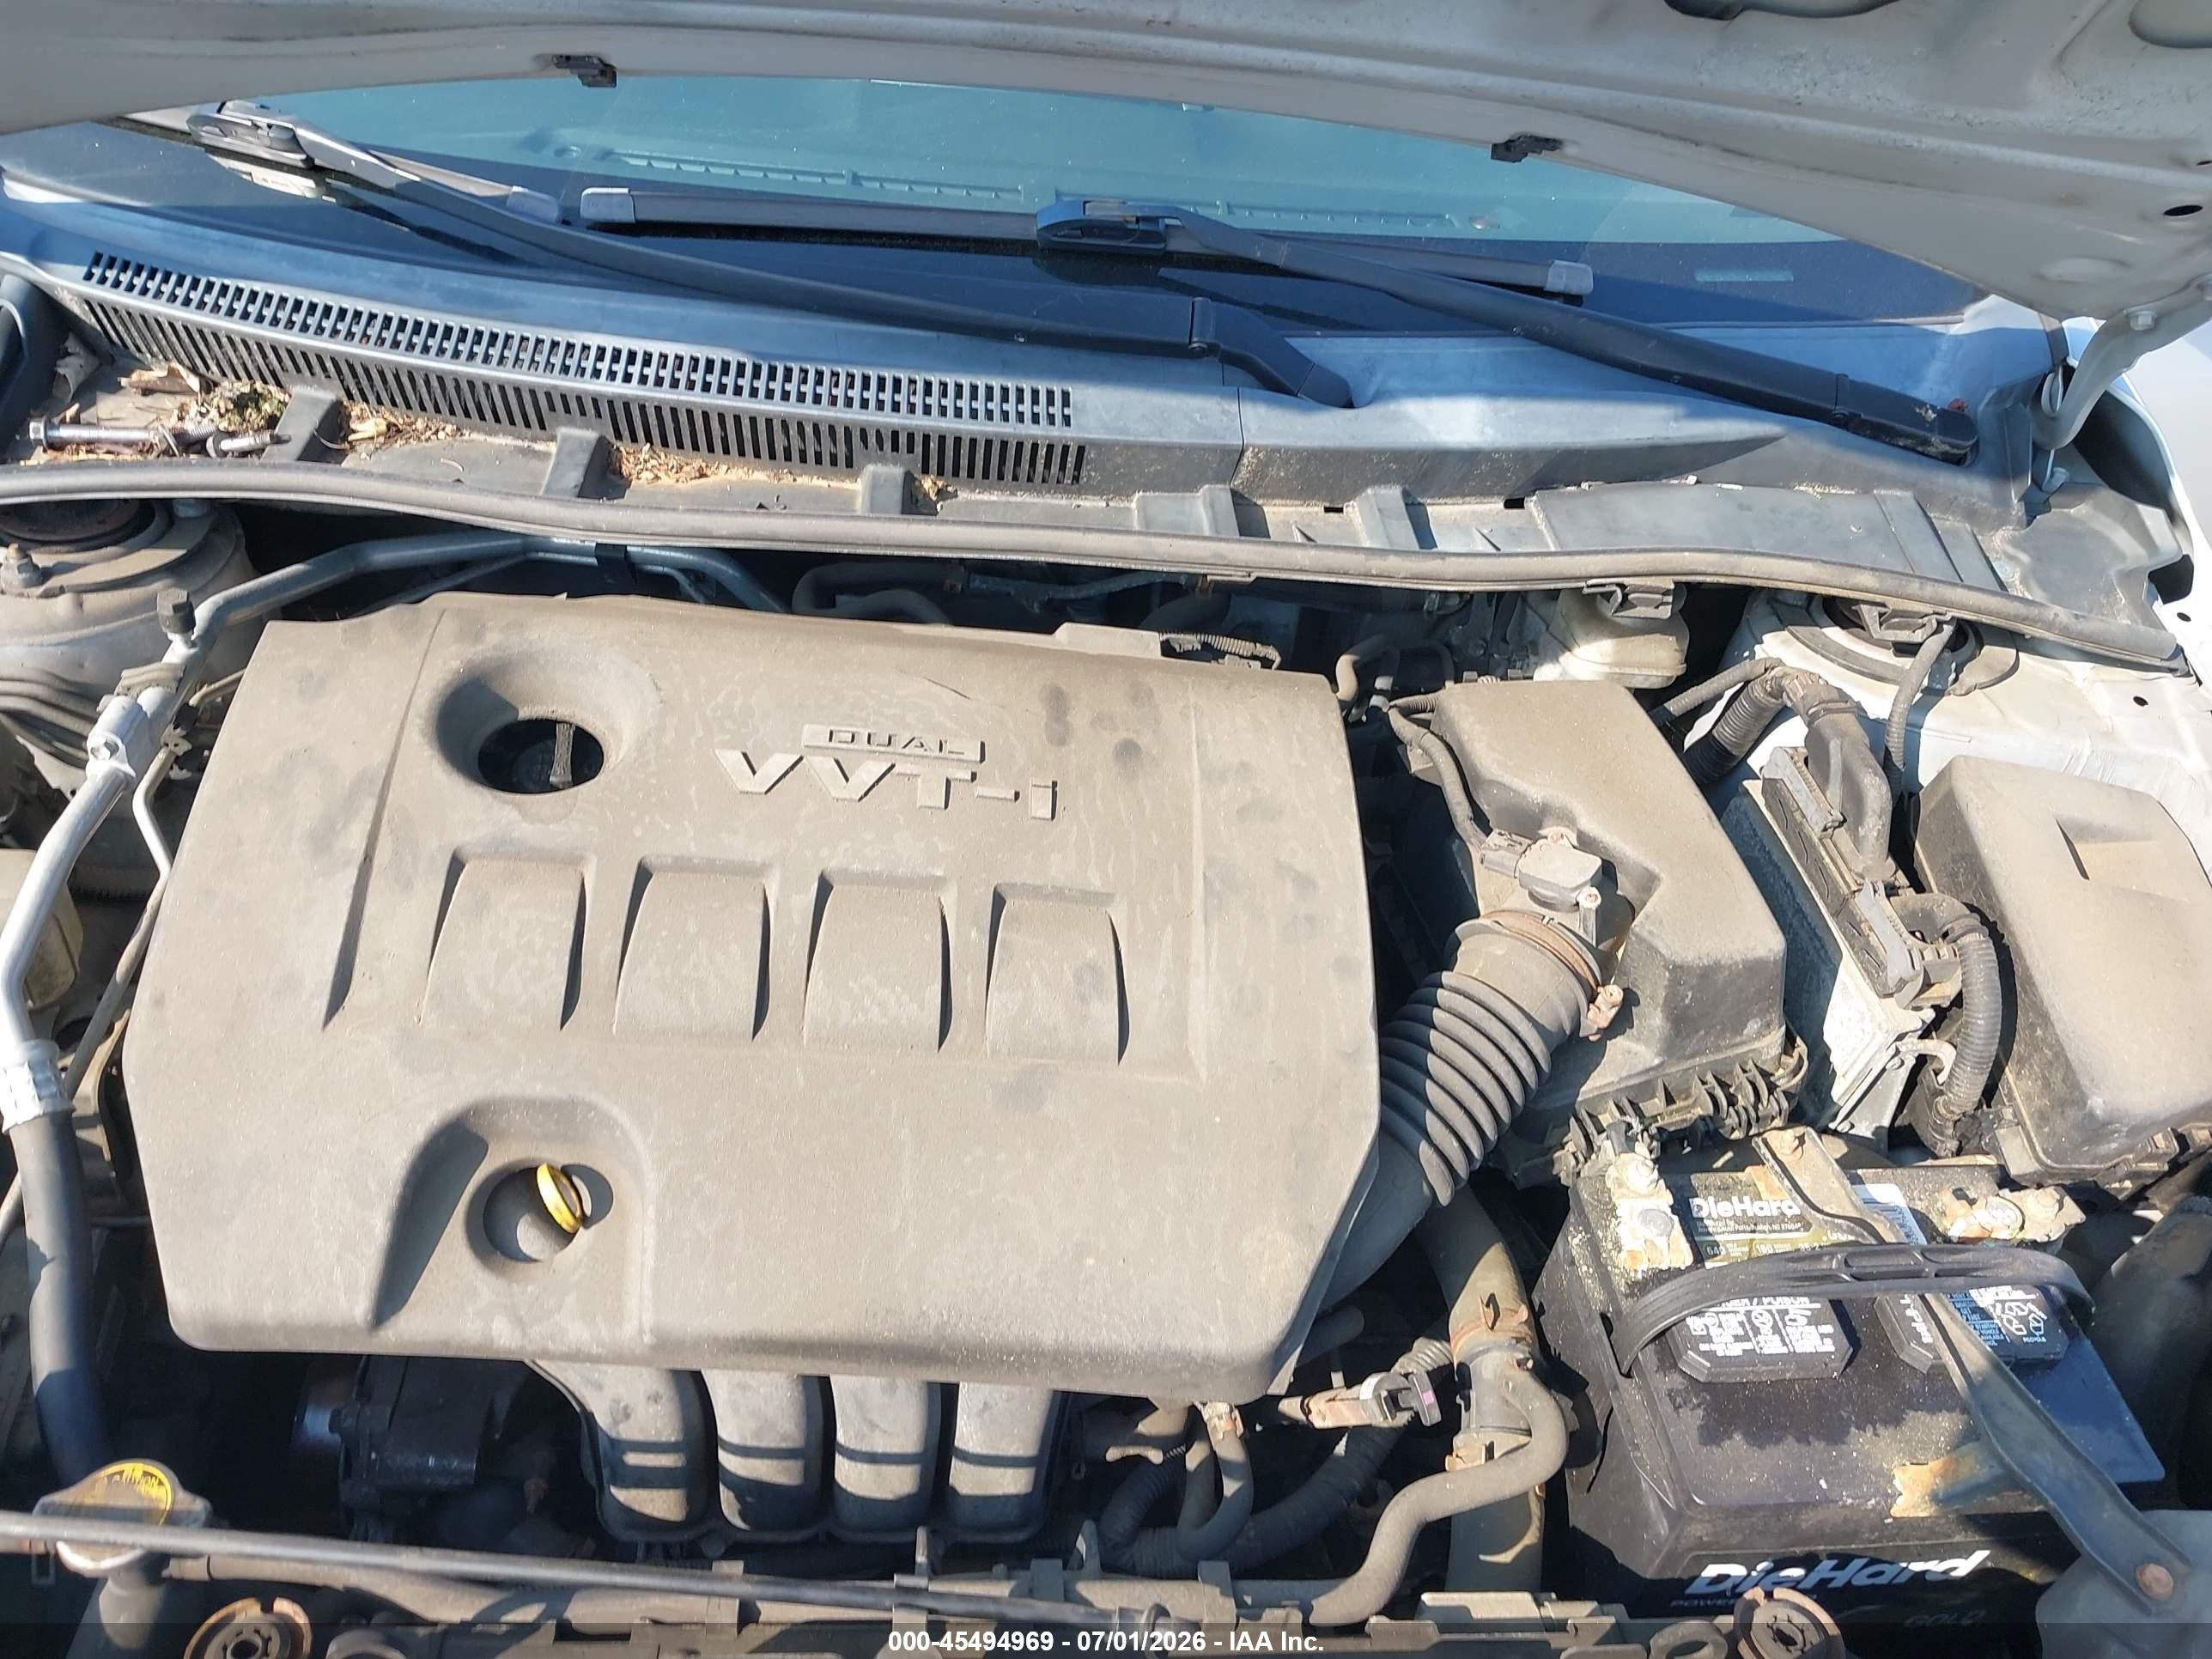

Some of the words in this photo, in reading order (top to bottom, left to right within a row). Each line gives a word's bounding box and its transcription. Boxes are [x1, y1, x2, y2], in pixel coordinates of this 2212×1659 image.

[830, 728, 967, 754] DUAL
[1689, 1196, 1801, 1218] DieHard
[1686, 1550, 1990, 1595] DieHard
